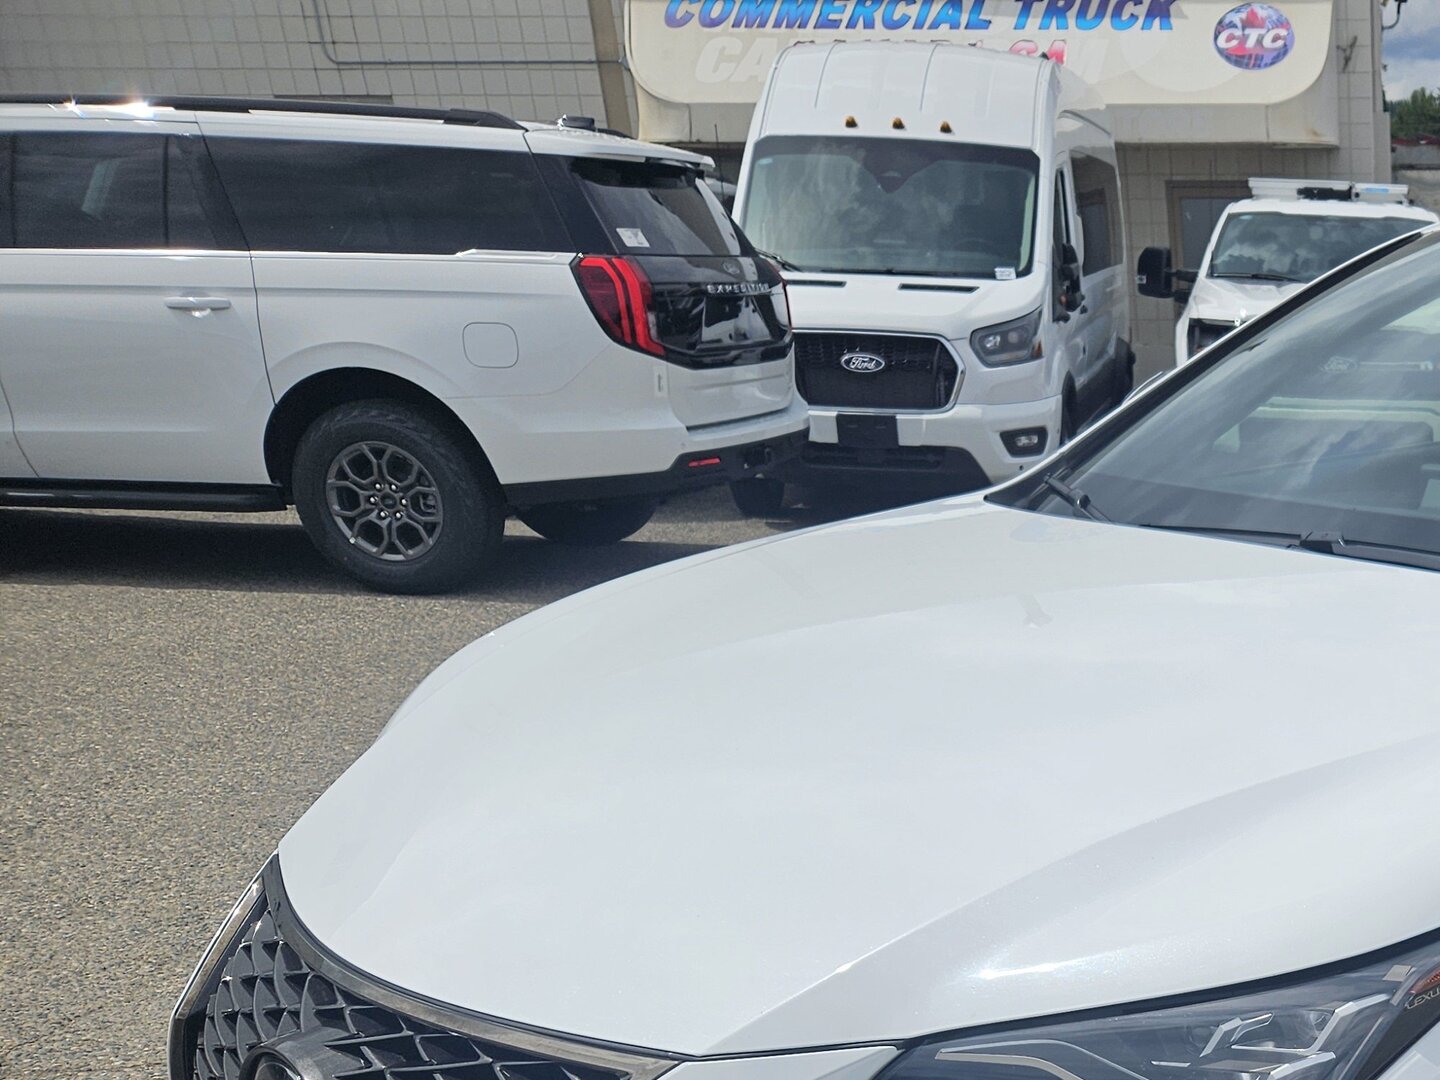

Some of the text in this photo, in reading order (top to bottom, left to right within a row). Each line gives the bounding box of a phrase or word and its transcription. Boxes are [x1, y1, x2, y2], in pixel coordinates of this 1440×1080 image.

[664, 0, 1173, 31] COMMERCIAL TRUCK
[1216, 27, 1288, 49] CTC
